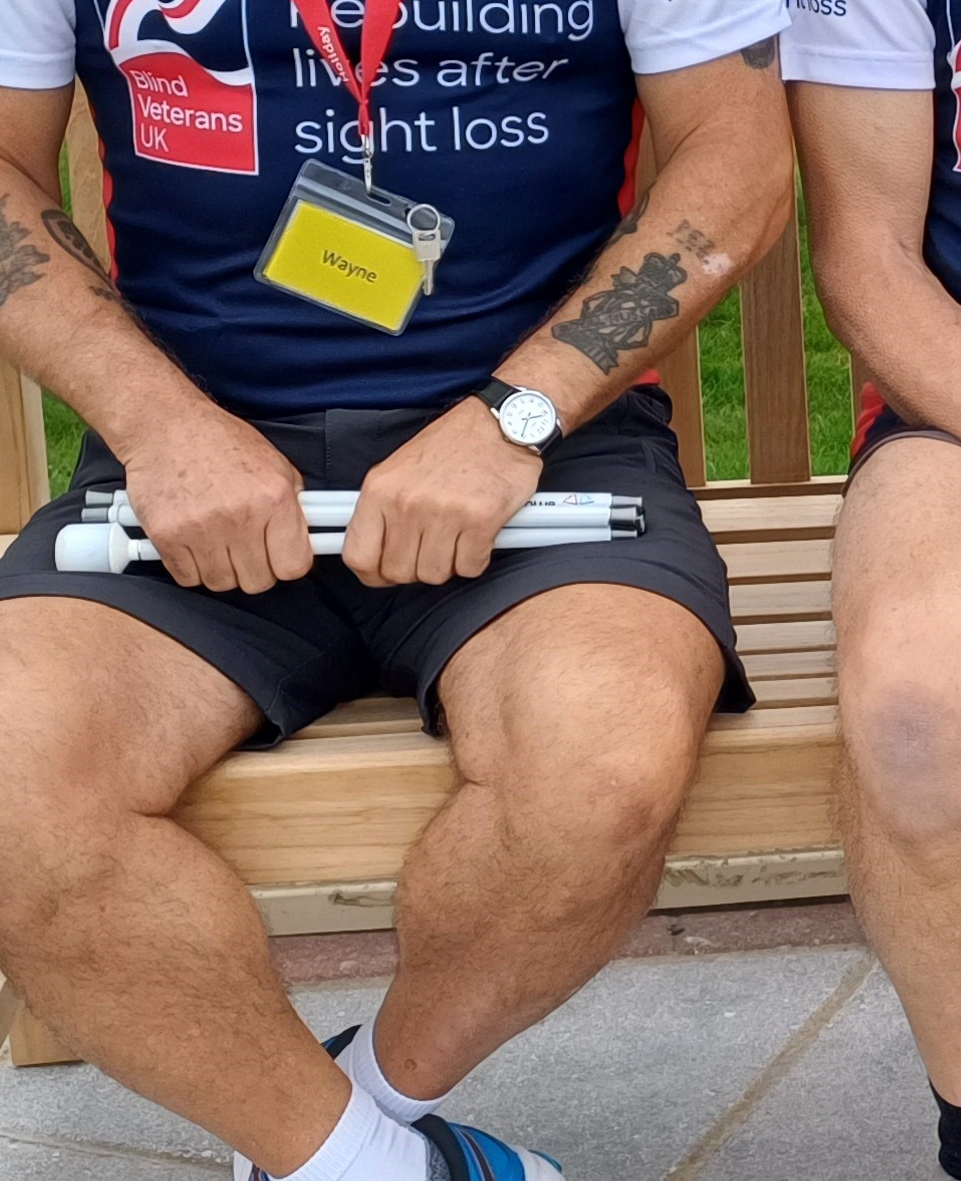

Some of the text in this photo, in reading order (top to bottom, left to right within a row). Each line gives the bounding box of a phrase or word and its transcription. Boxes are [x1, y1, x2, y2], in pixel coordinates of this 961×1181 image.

[317, 26, 349, 82] Holiday
[437, 52, 569, 86] after
[129, 70, 188, 97] Blind
[137, 93, 243, 132] Veterans
[140, 123, 169, 152] UK
[294, 106, 549, 164] sight loss
[322, 249, 378, 283] Wayne
